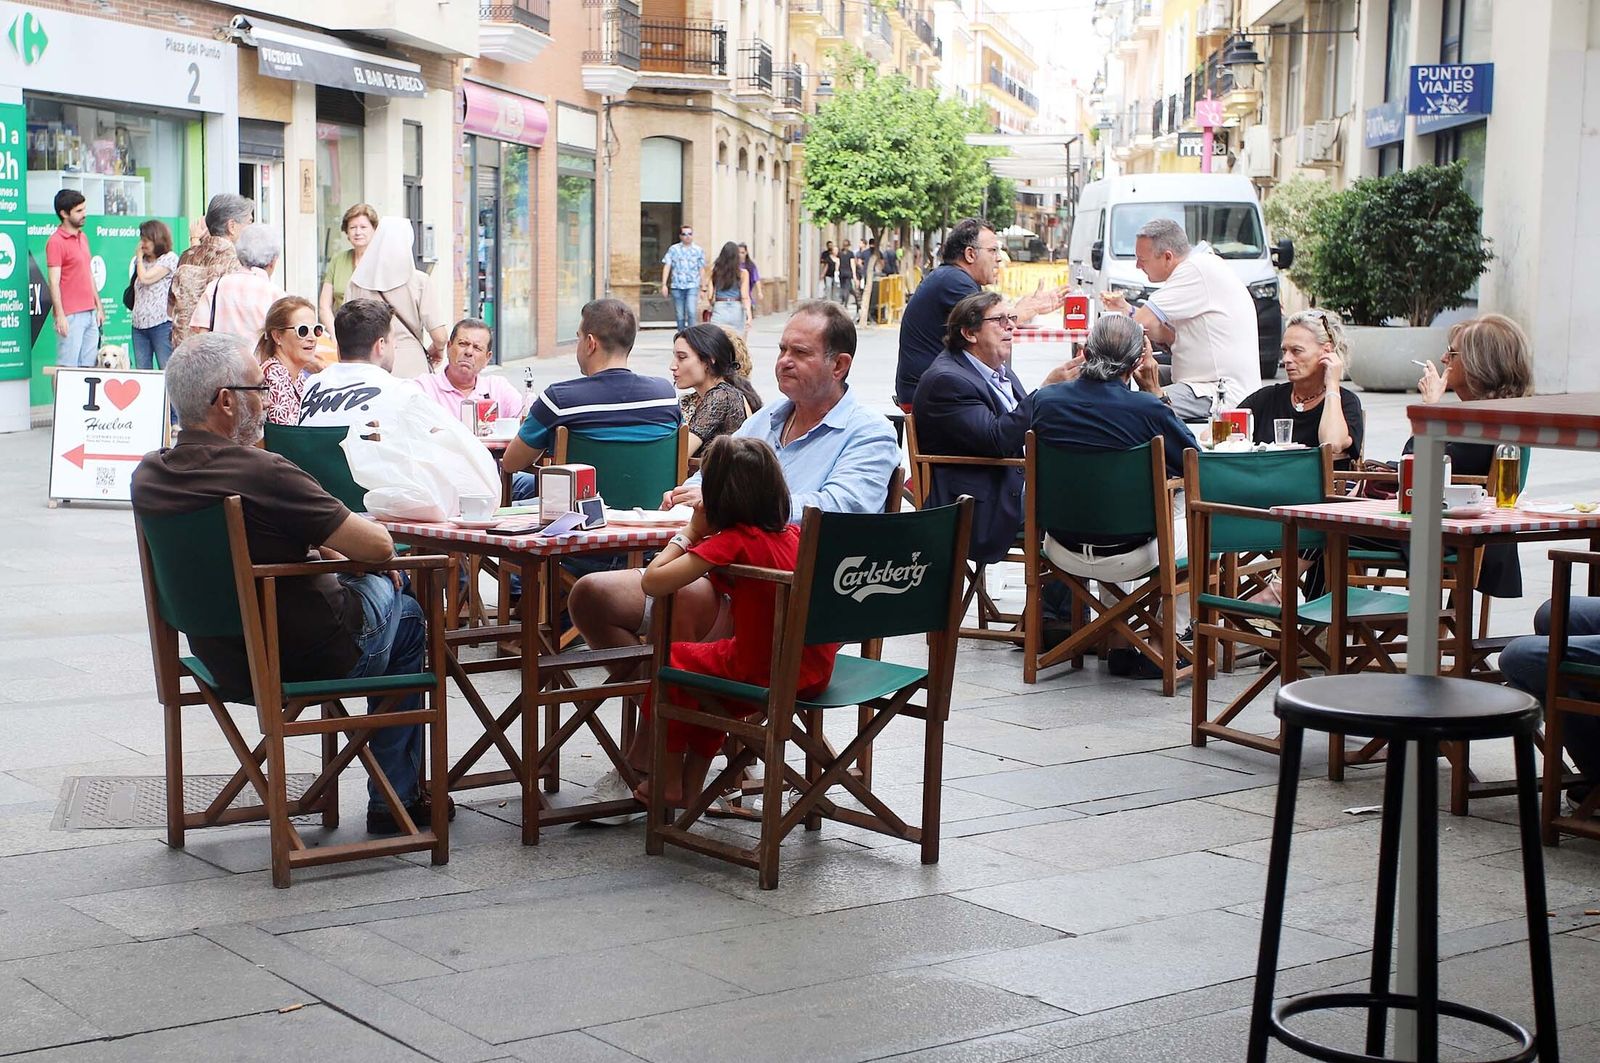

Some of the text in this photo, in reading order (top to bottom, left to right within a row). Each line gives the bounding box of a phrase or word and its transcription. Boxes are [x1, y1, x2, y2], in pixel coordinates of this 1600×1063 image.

[165, 37, 221, 60] Plaza del Punto
[262, 47, 303, 66] VICTORIA
[187, 62, 201, 104] 2
[353, 67, 424, 92] EL BAR DE DIEGO
[1417, 66, 1474, 81] PUNTO
[1418, 80, 1474, 94] VIAJES
[11, 130, 19, 145] a
[96, 226, 109, 237] Por
[108, 227, 120, 237] ser
[119, 226, 136, 237] socio
[82, 377, 102, 412] I
[84, 416, 133, 431] Huelva
[833, 553, 932, 603] Carlsberg
